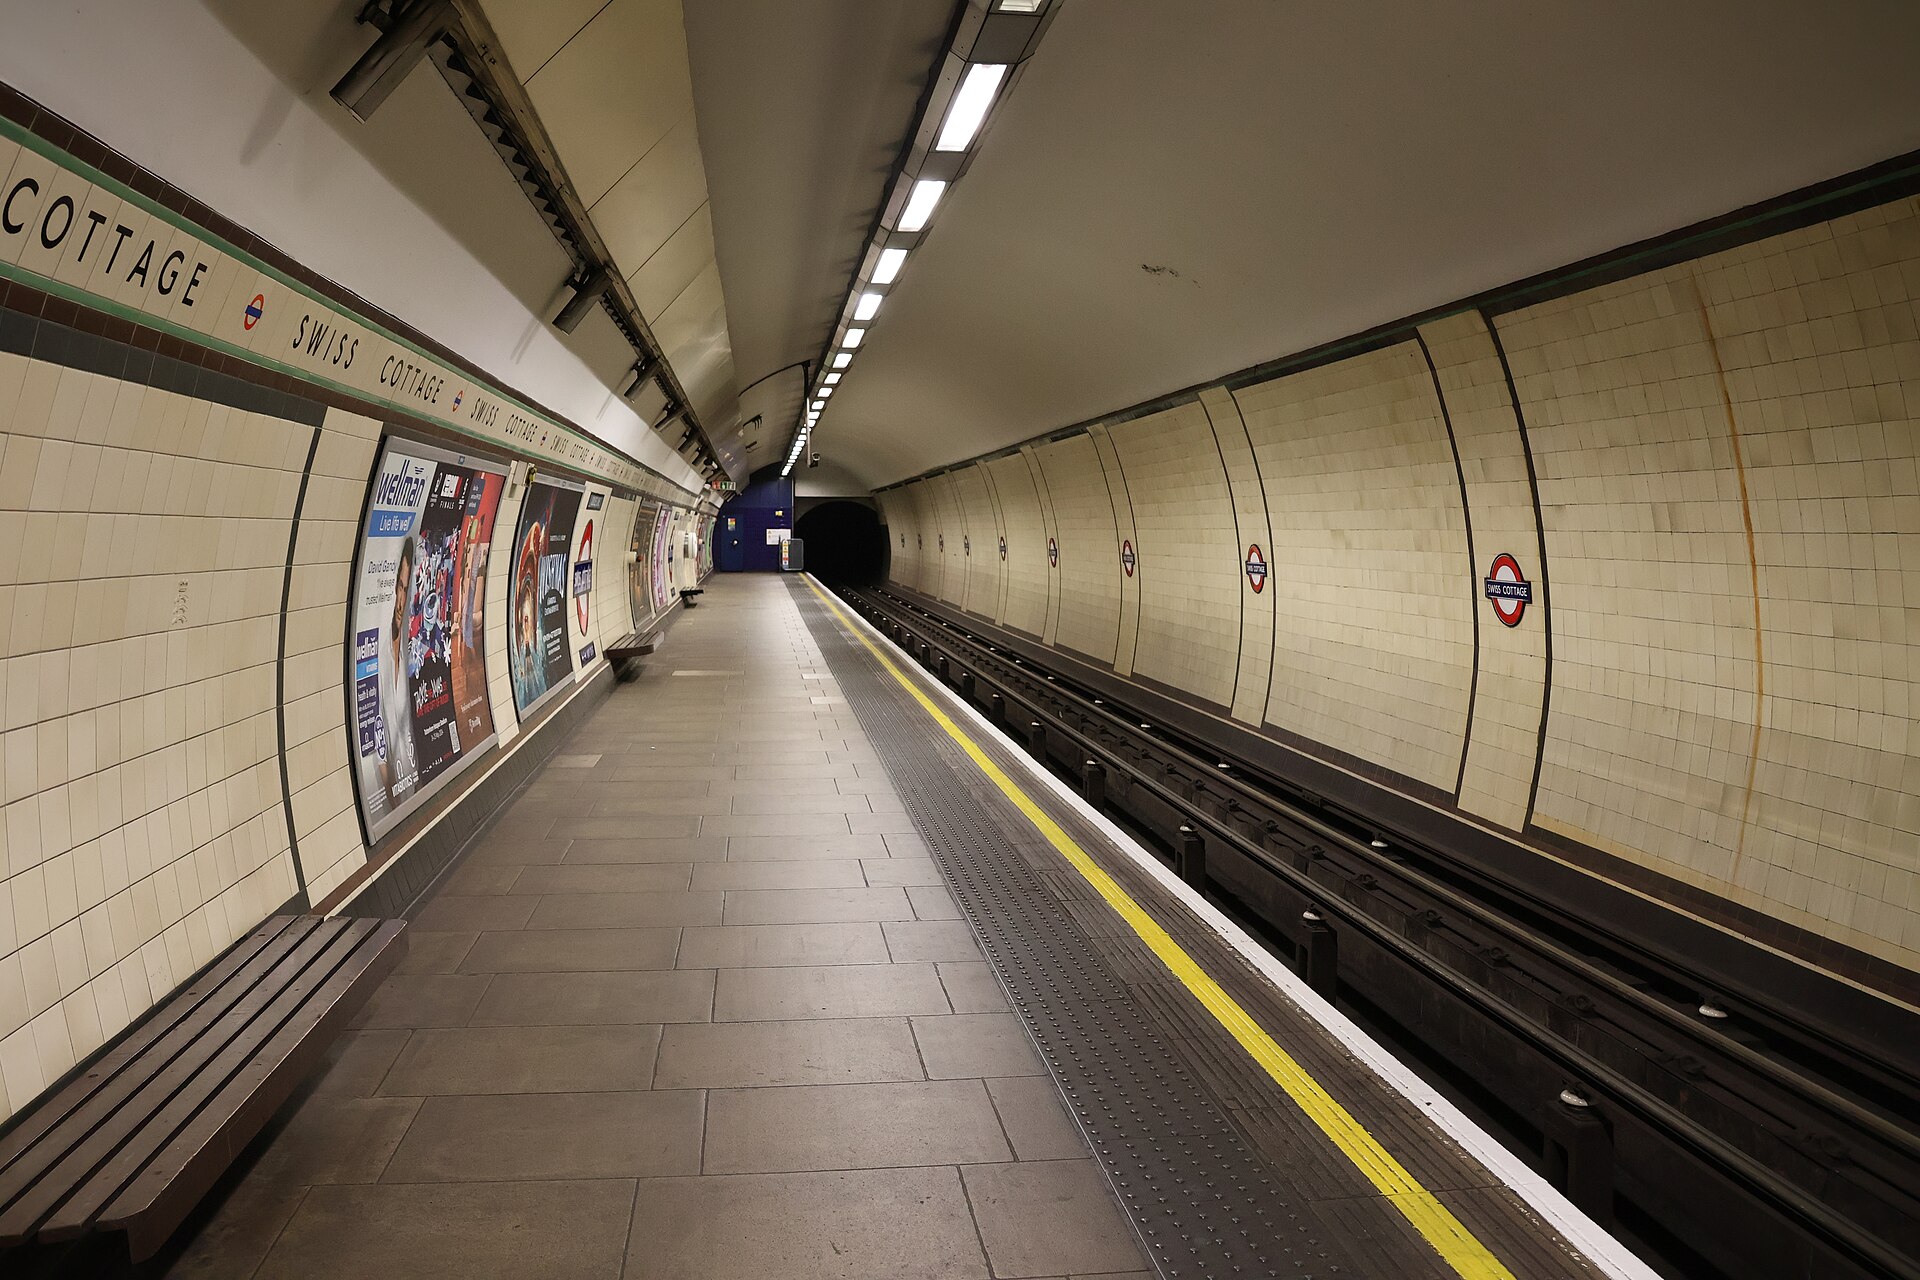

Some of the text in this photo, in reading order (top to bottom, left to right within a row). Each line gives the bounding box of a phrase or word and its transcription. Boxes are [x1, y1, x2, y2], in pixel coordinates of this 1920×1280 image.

[2, 177, 208, 307] COTTAGE
[292, 314, 445, 404] SWISS COTTAGE
[470, 397, 538, 443] SWISS COTTAGE
[376, 459, 427, 507] wellman
[1488, 583, 1528, 597] SWISS COTTAGE
